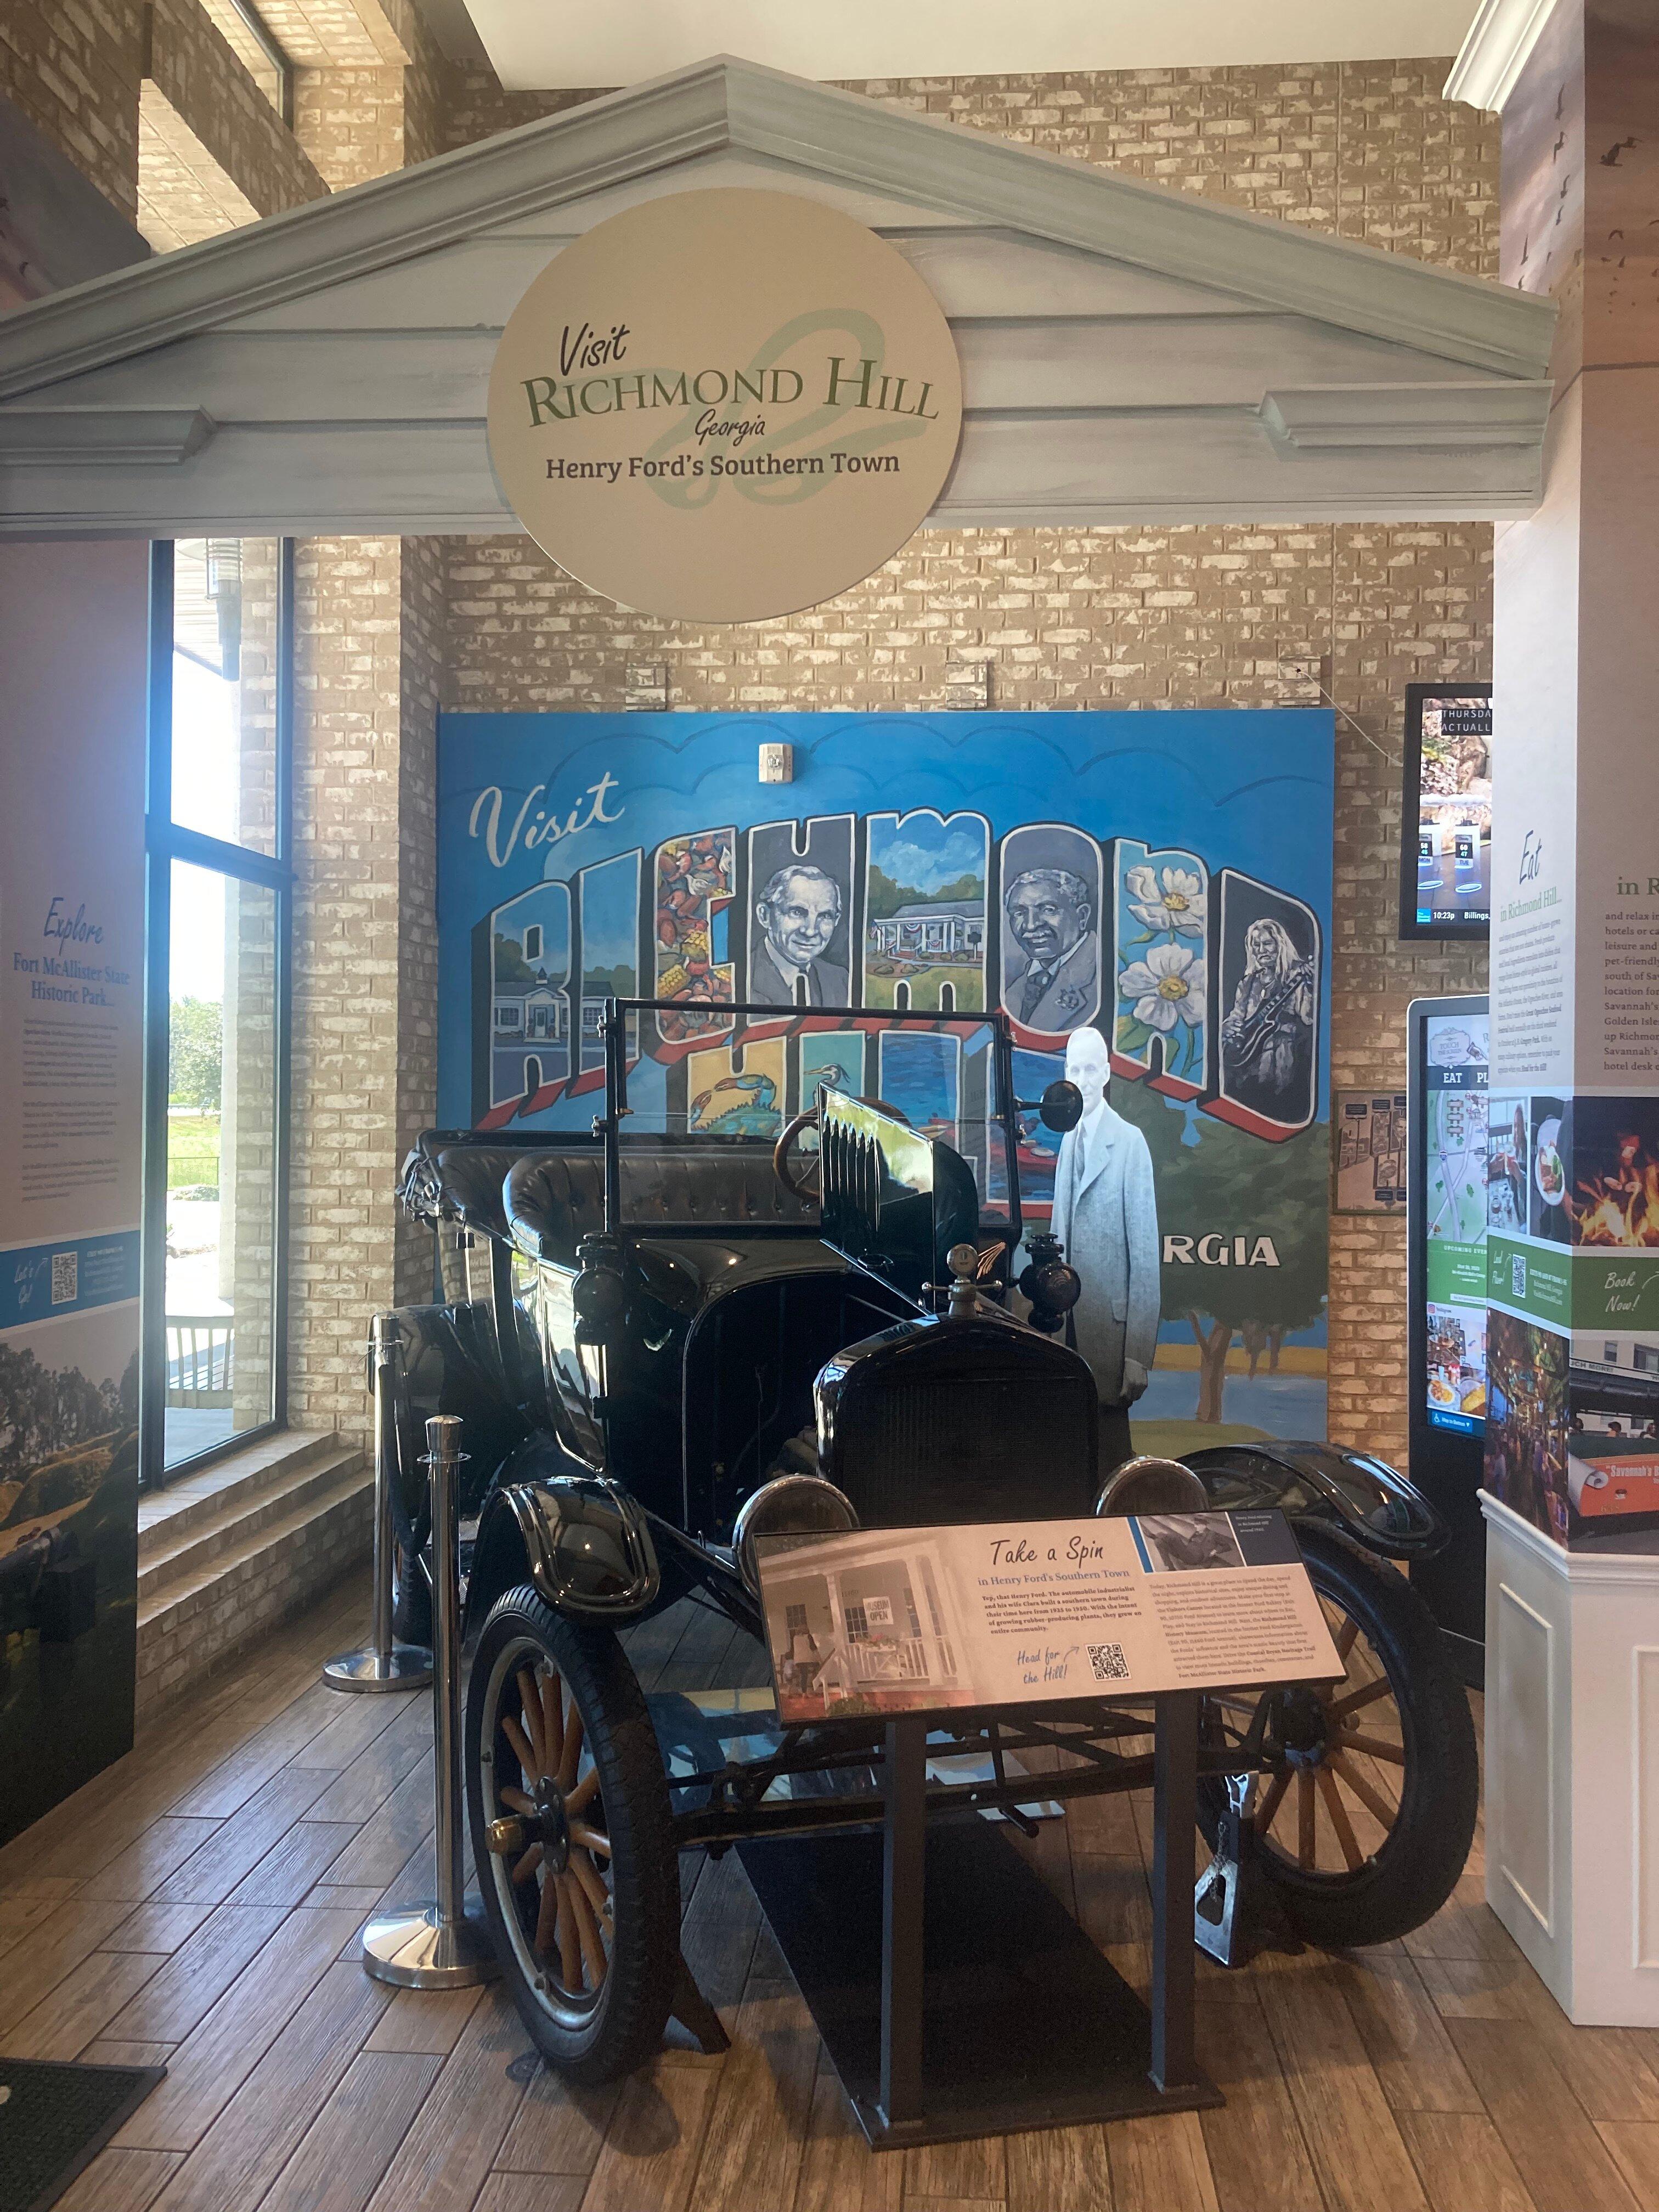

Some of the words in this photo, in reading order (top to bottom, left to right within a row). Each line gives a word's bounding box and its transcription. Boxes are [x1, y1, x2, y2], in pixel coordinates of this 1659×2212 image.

[560, 323, 630, 376] Visit
[521, 369, 804, 427] RICHMOND
[823, 357, 940, 419] HILL
[695, 409, 766, 445] Georgia
[546, 459, 622, 483] Henry
[629, 455, 703, 477] Ford's
[710, 454, 825, 476] Southern
[831, 453, 900, 474] Town
[469, 771, 626, 867] Visit
[1519, 830, 1542, 885] Eat
[1617, 877, 1640, 895] in
[1500, 905, 1507, 922] in
[1508, 891, 1542, 920] Richmond
[1605, 911, 1623, 920] and
[1626, 911, 1650, 920] relax
[1433, 911, 1455, 921] 10:23p
[44, 898, 104, 957] Explore
[1605, 927, 1634, 935] hotels
[1605, 941, 1637, 950] leisure
[14, 952, 38, 973] Fort
[43, 957, 102, 981] McAllister
[105, 966, 130, 985] State
[1605, 972, 1632, 980] south
[31, 980, 79, 1003] Historic
[1605, 986, 1643, 995] location
[1604, 1002, 1658, 1010] Savannah's
[1604, 1017, 1638, 1025] Golden
[1641, 1017, 1659, 1025] Isle
[1604, 1034, 1616, 1042] up
[1604, 1047, 1657, 1056] Savannah's
[1604, 1062, 1628, 1070] hotel
[1631, 1062, 1652, 1070] desk
[1443, 1073, 1462, 1083] EAT
[1477, 1073, 1489, 1083] PL
[1163, 1233, 1280, 1266] RGIA
[1605, 1271, 1636, 1289] Book
[1605, 1294, 1640, 1312] Now!
[991, 1539, 1038, 1566] Take
[1047, 1548, 1057, 1561] a
[1066, 1536, 1103, 1568] Spin
[991, 1576, 1021, 1586] Henry
[1024, 1573, 1053, 1582] Ford's
[1056, 1571, 1100, 1581] Southern
[1103, 1569, 1130, 1578] Town
[867, 1600, 889, 1611] MUSEUM
[870, 1611, 888, 1621] OPEN
[1018, 1649, 1041, 1665] Head
[1045, 1647, 1060, 1665] for
[1024, 1672, 1039, 1684] the
[1044, 1664, 1067, 1682] Hill!
